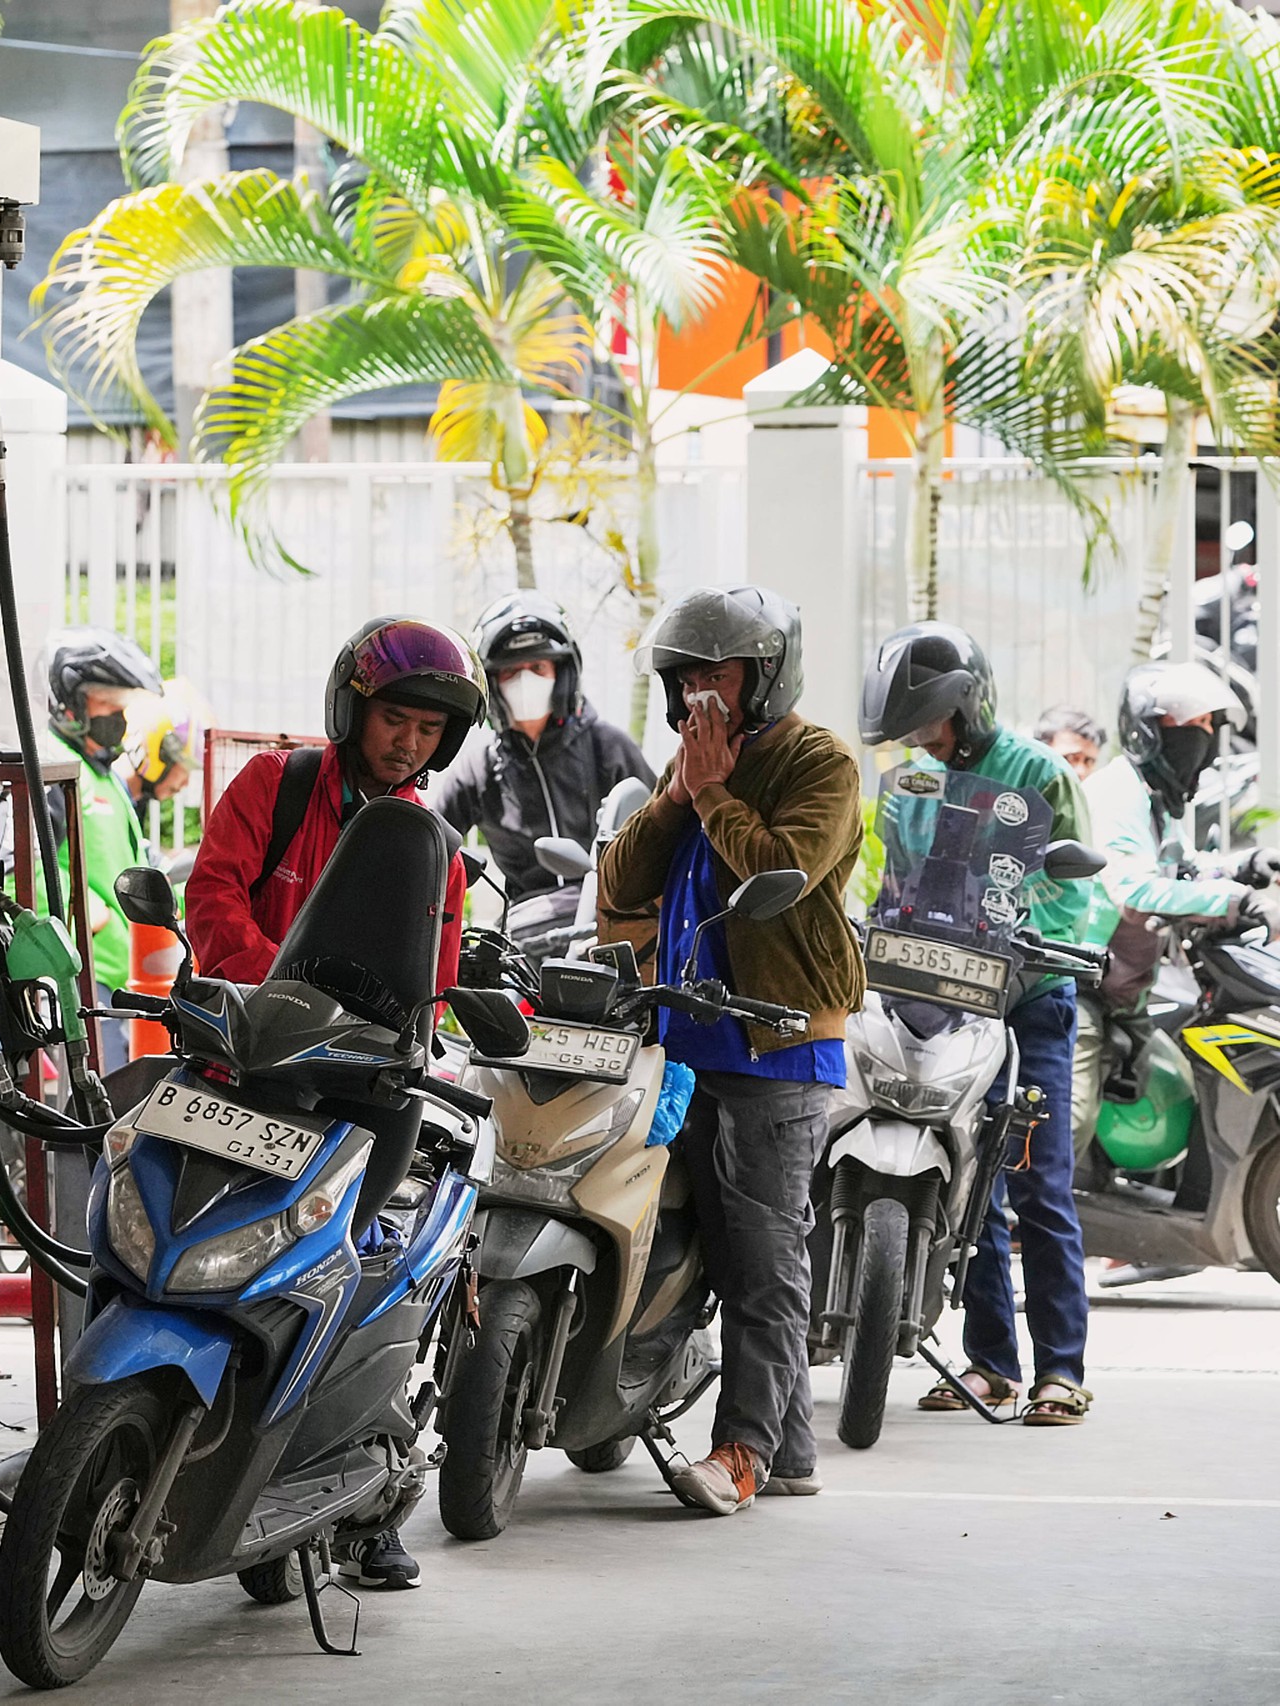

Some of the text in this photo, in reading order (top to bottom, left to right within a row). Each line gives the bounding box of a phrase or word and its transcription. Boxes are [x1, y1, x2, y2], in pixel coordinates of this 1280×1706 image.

[875, 938, 1003, 986] B 5365 FPT
[560, 974, 594, 983] HONDA
[267, 992, 311, 1010] HONDA
[327, 1051, 374, 1062] TECHNO
[158, 1086, 313, 1153] B 6857 SZN
[295, 1248, 343, 1287] HONDA
